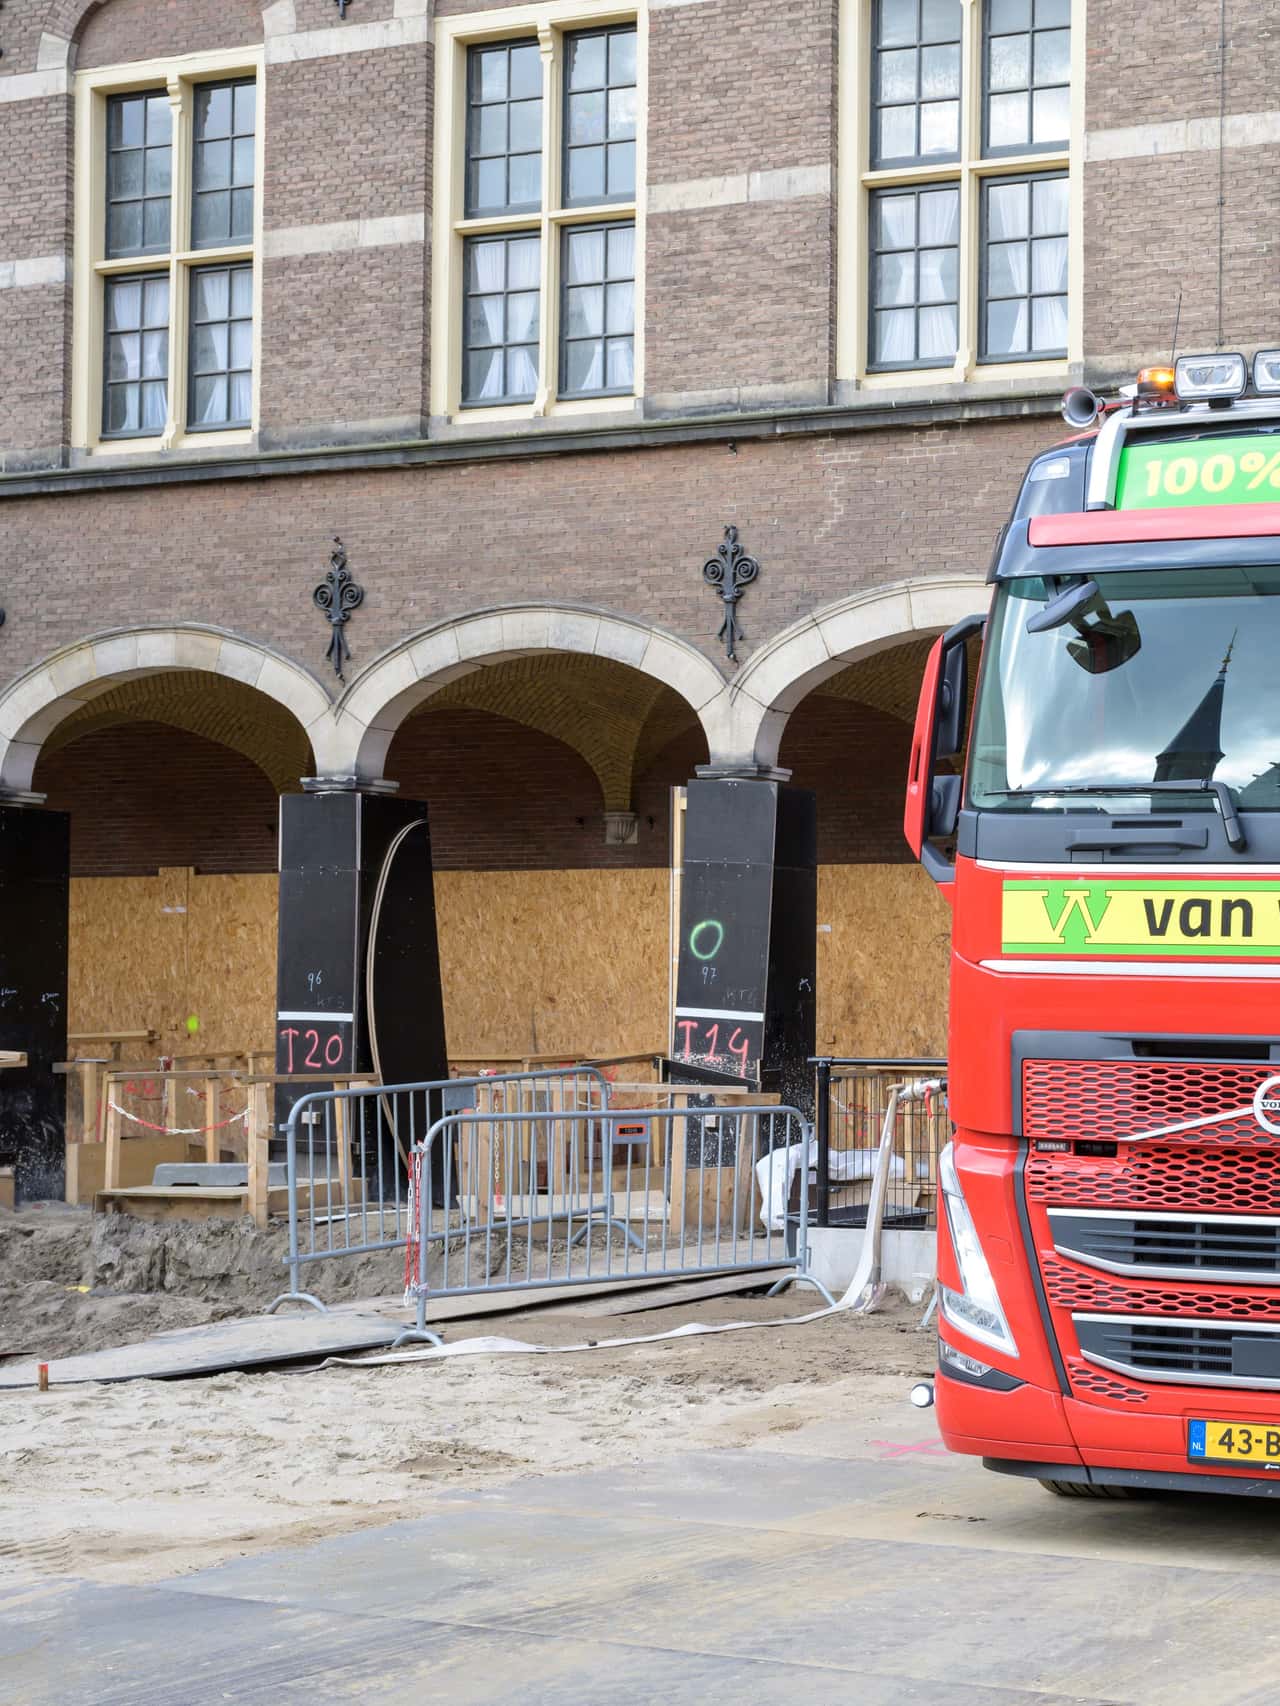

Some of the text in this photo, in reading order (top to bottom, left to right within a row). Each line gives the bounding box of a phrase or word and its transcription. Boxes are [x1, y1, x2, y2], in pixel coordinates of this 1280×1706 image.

[1143, 897, 1255, 938] van
[307, 970, 322, 992] 96
[279, 1027, 344, 1074] T20
[1192, 1441, 1204, 1451] NL
